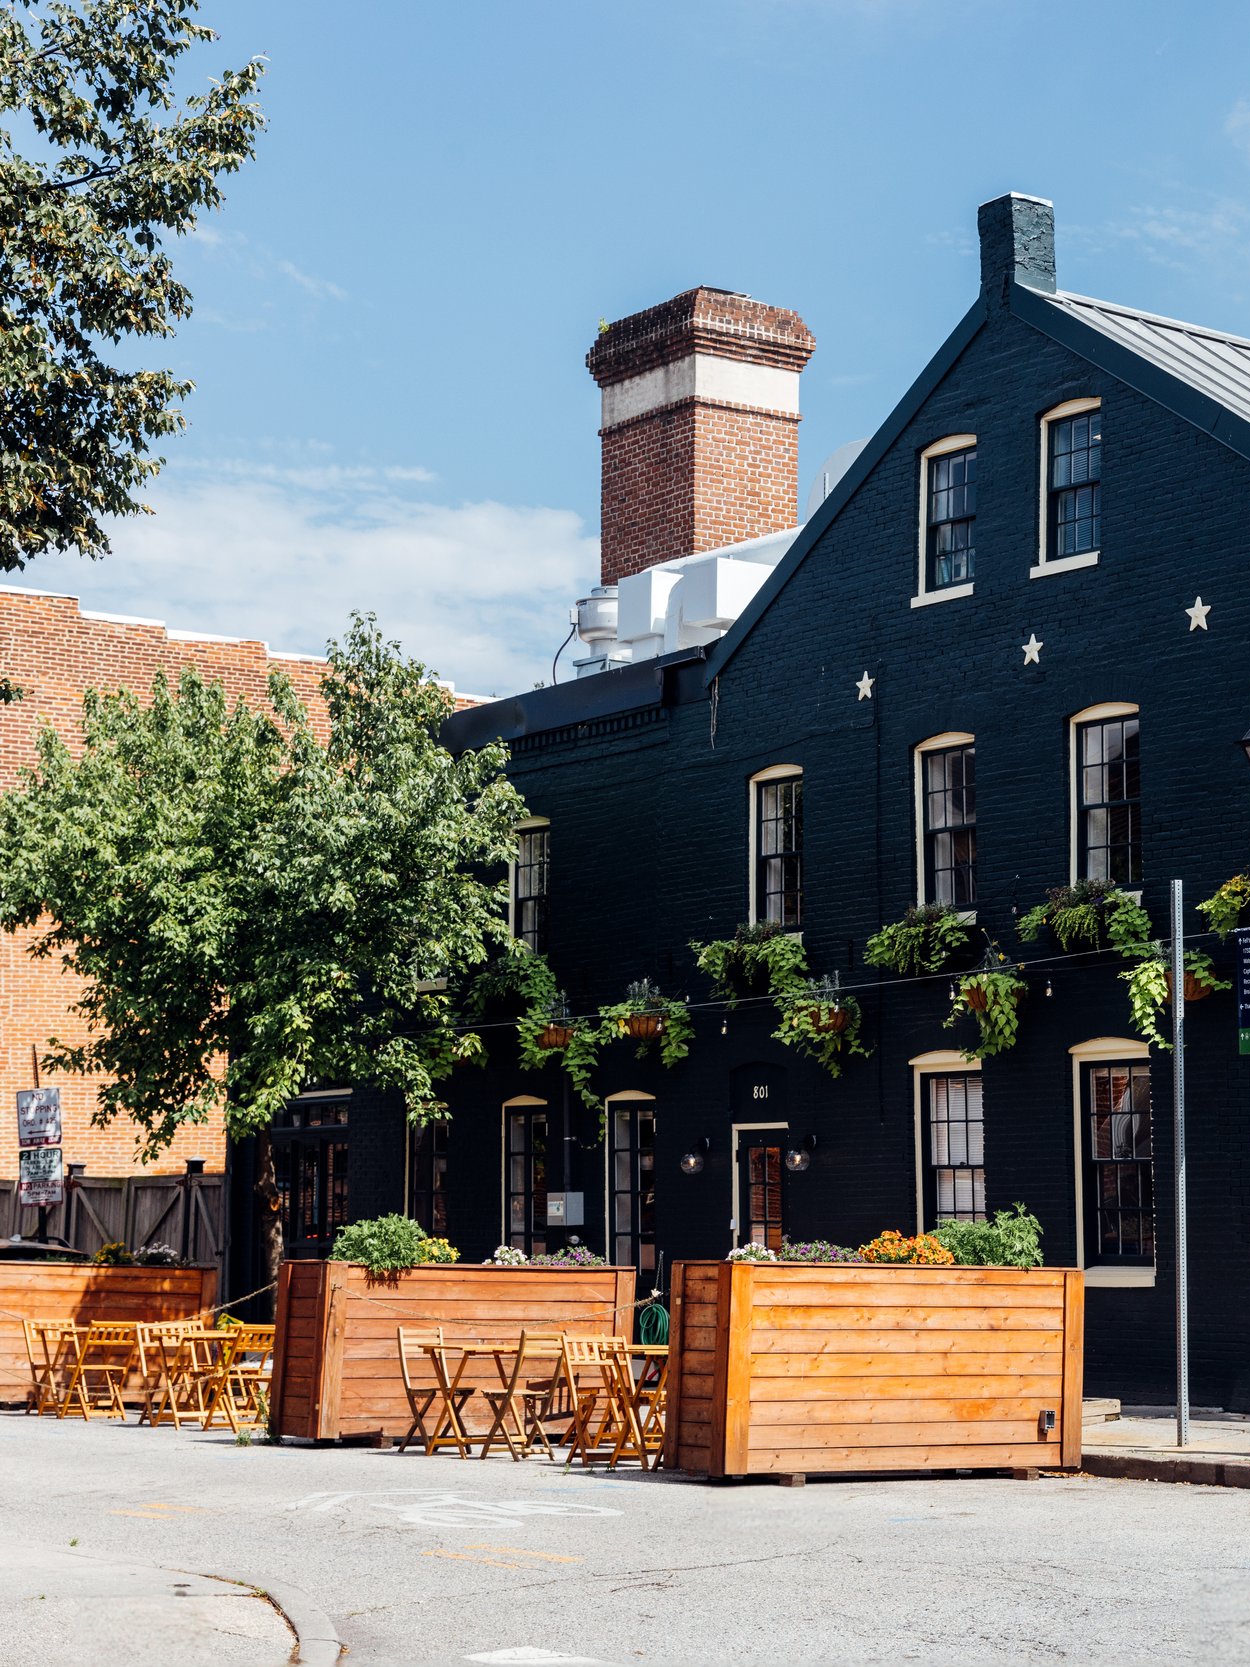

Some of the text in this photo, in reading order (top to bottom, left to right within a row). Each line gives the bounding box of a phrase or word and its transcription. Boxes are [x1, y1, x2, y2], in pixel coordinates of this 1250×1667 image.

[753, 1085, 768, 1099] 801
[20, 1104, 57, 1115] STPPING
[34, 1150, 59, 1159] HOUR
